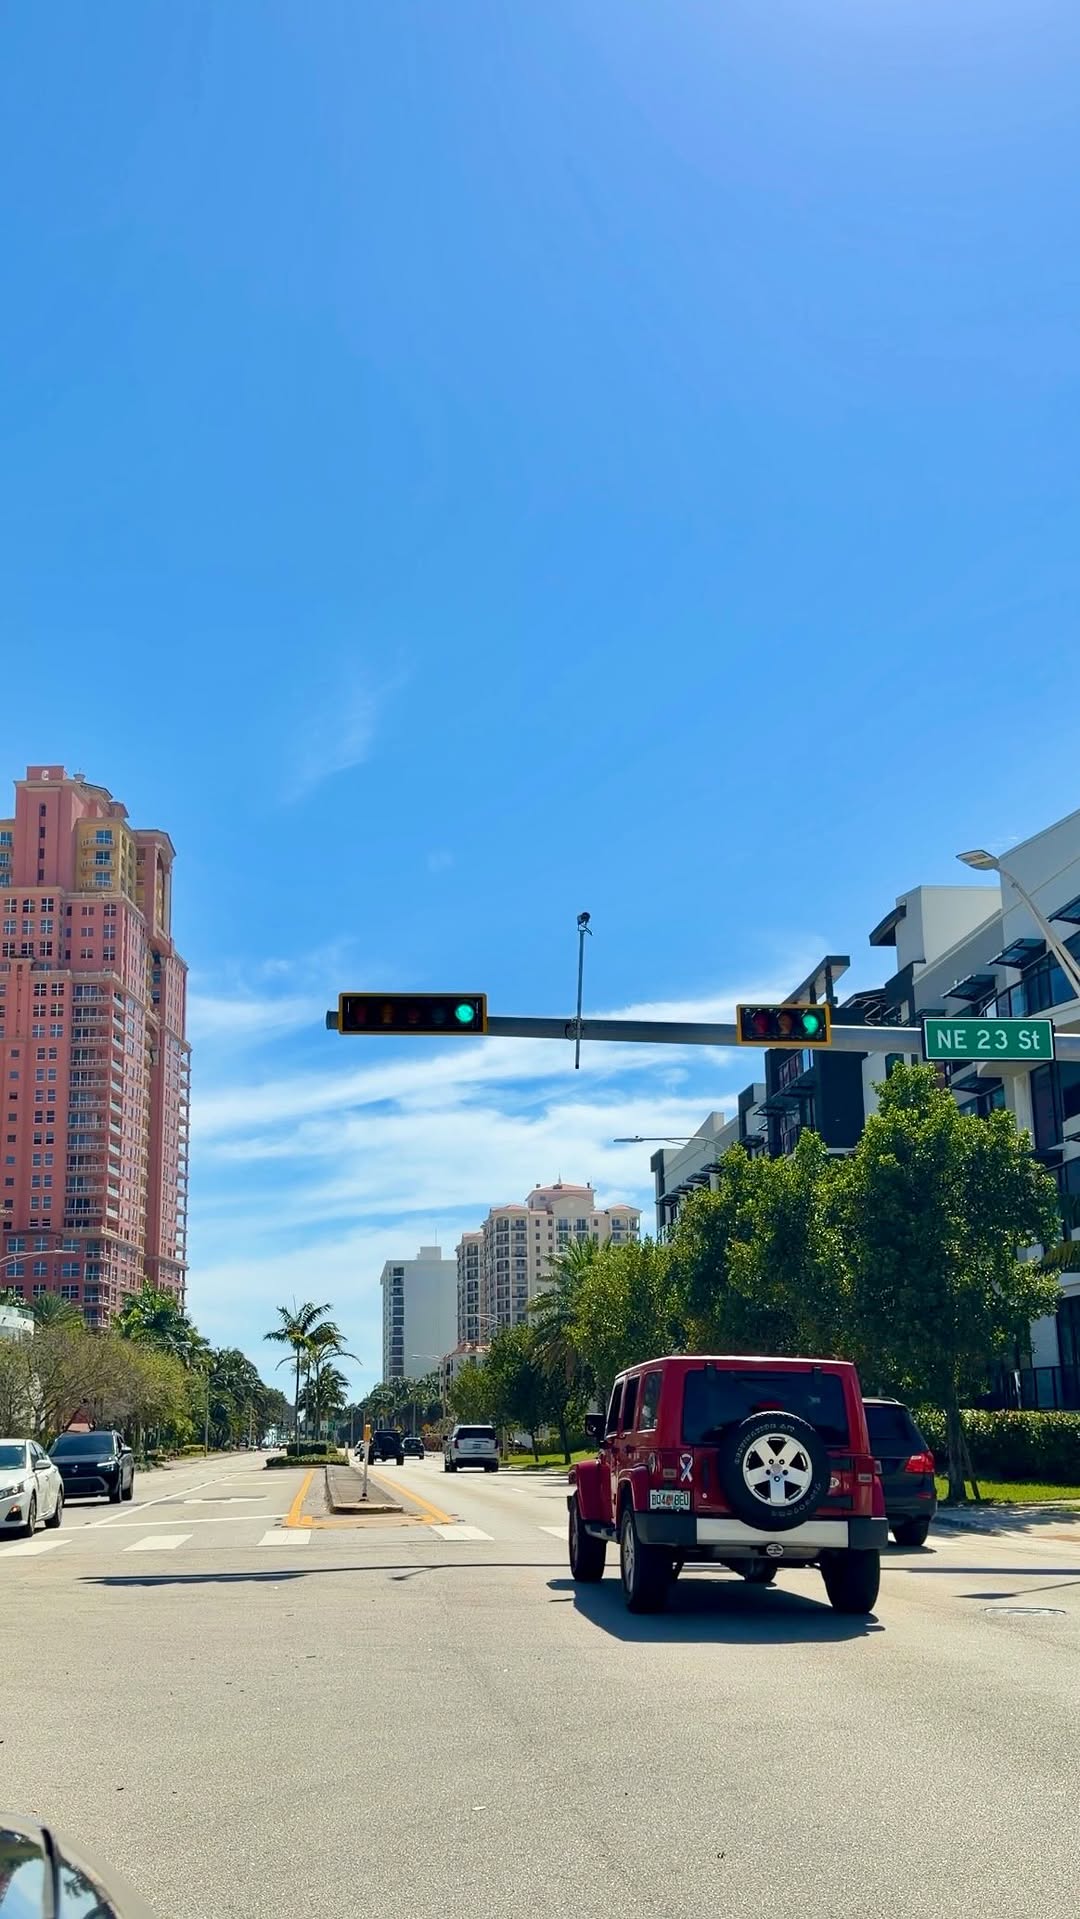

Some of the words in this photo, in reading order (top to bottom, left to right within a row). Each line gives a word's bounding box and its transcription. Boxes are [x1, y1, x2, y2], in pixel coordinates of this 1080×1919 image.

[937, 1029, 967, 1049] NE
[977, 1029, 1008, 1050] 23
[1018, 1029, 1040, 1050] St
